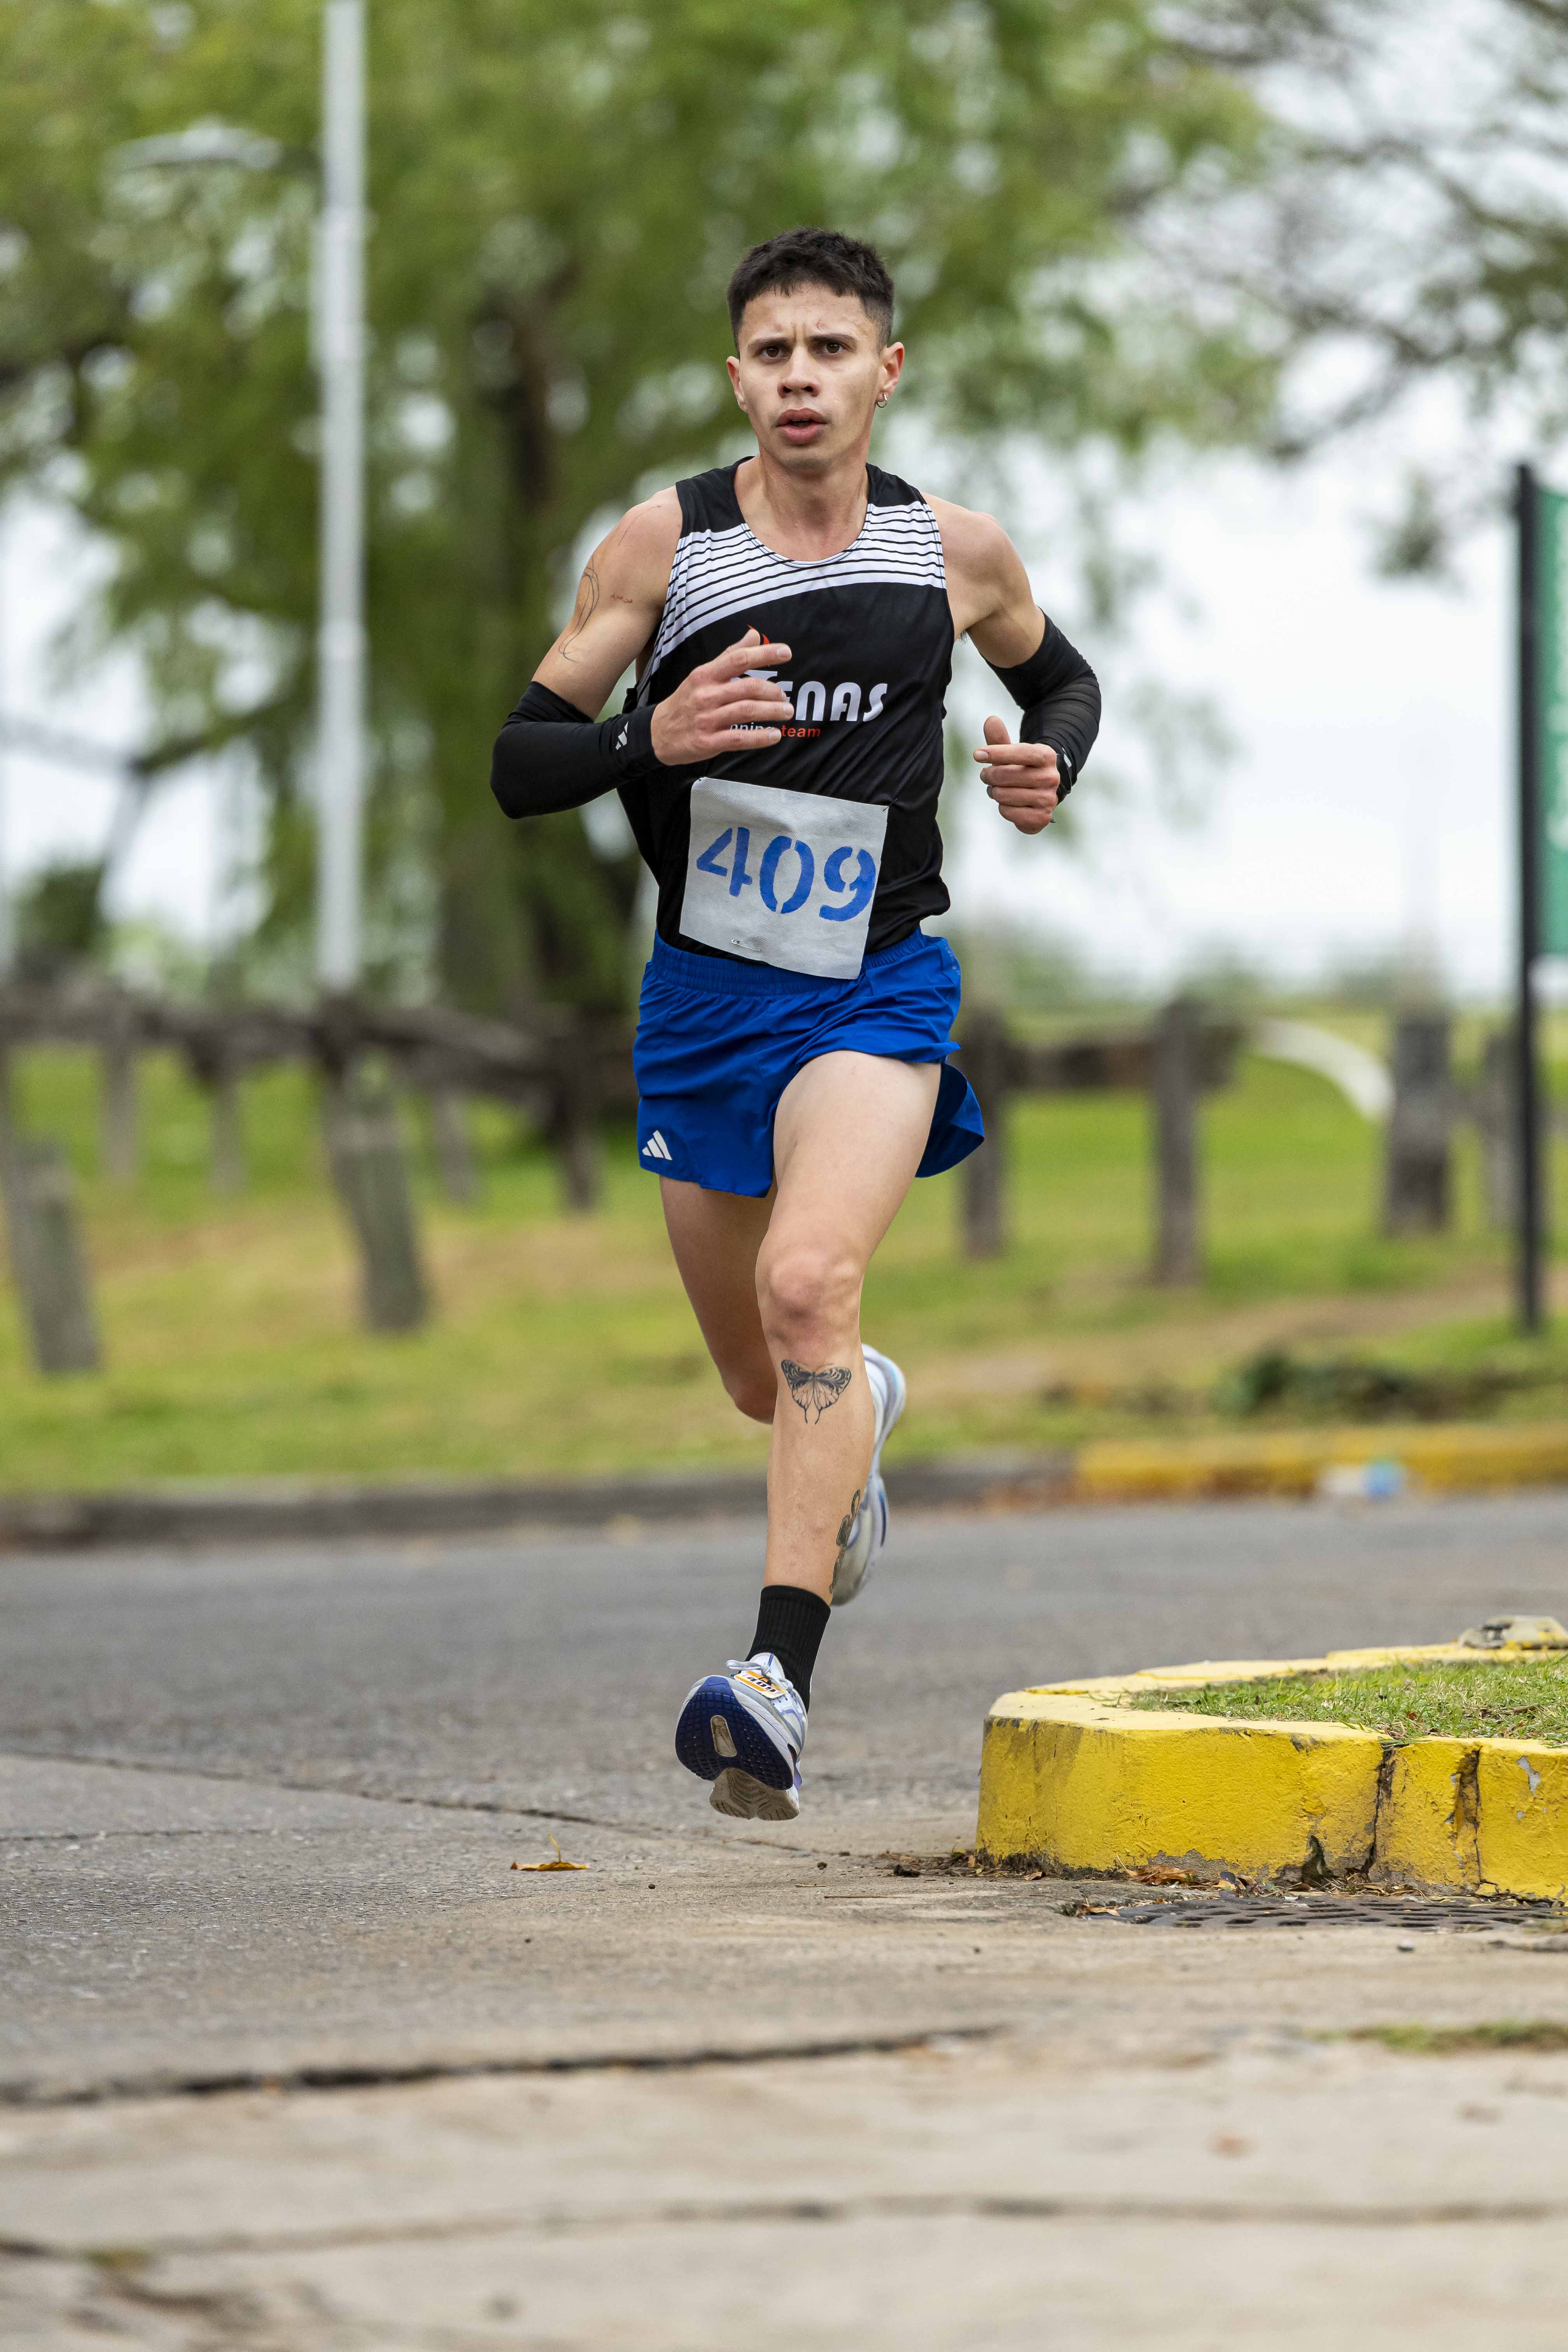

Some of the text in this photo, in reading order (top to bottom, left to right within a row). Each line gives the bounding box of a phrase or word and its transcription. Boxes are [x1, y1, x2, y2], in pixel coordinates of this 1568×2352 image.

[781, 725, 821, 737] team
[696, 827, 876, 921] 409
[747, 1676, 776, 1692] 409
